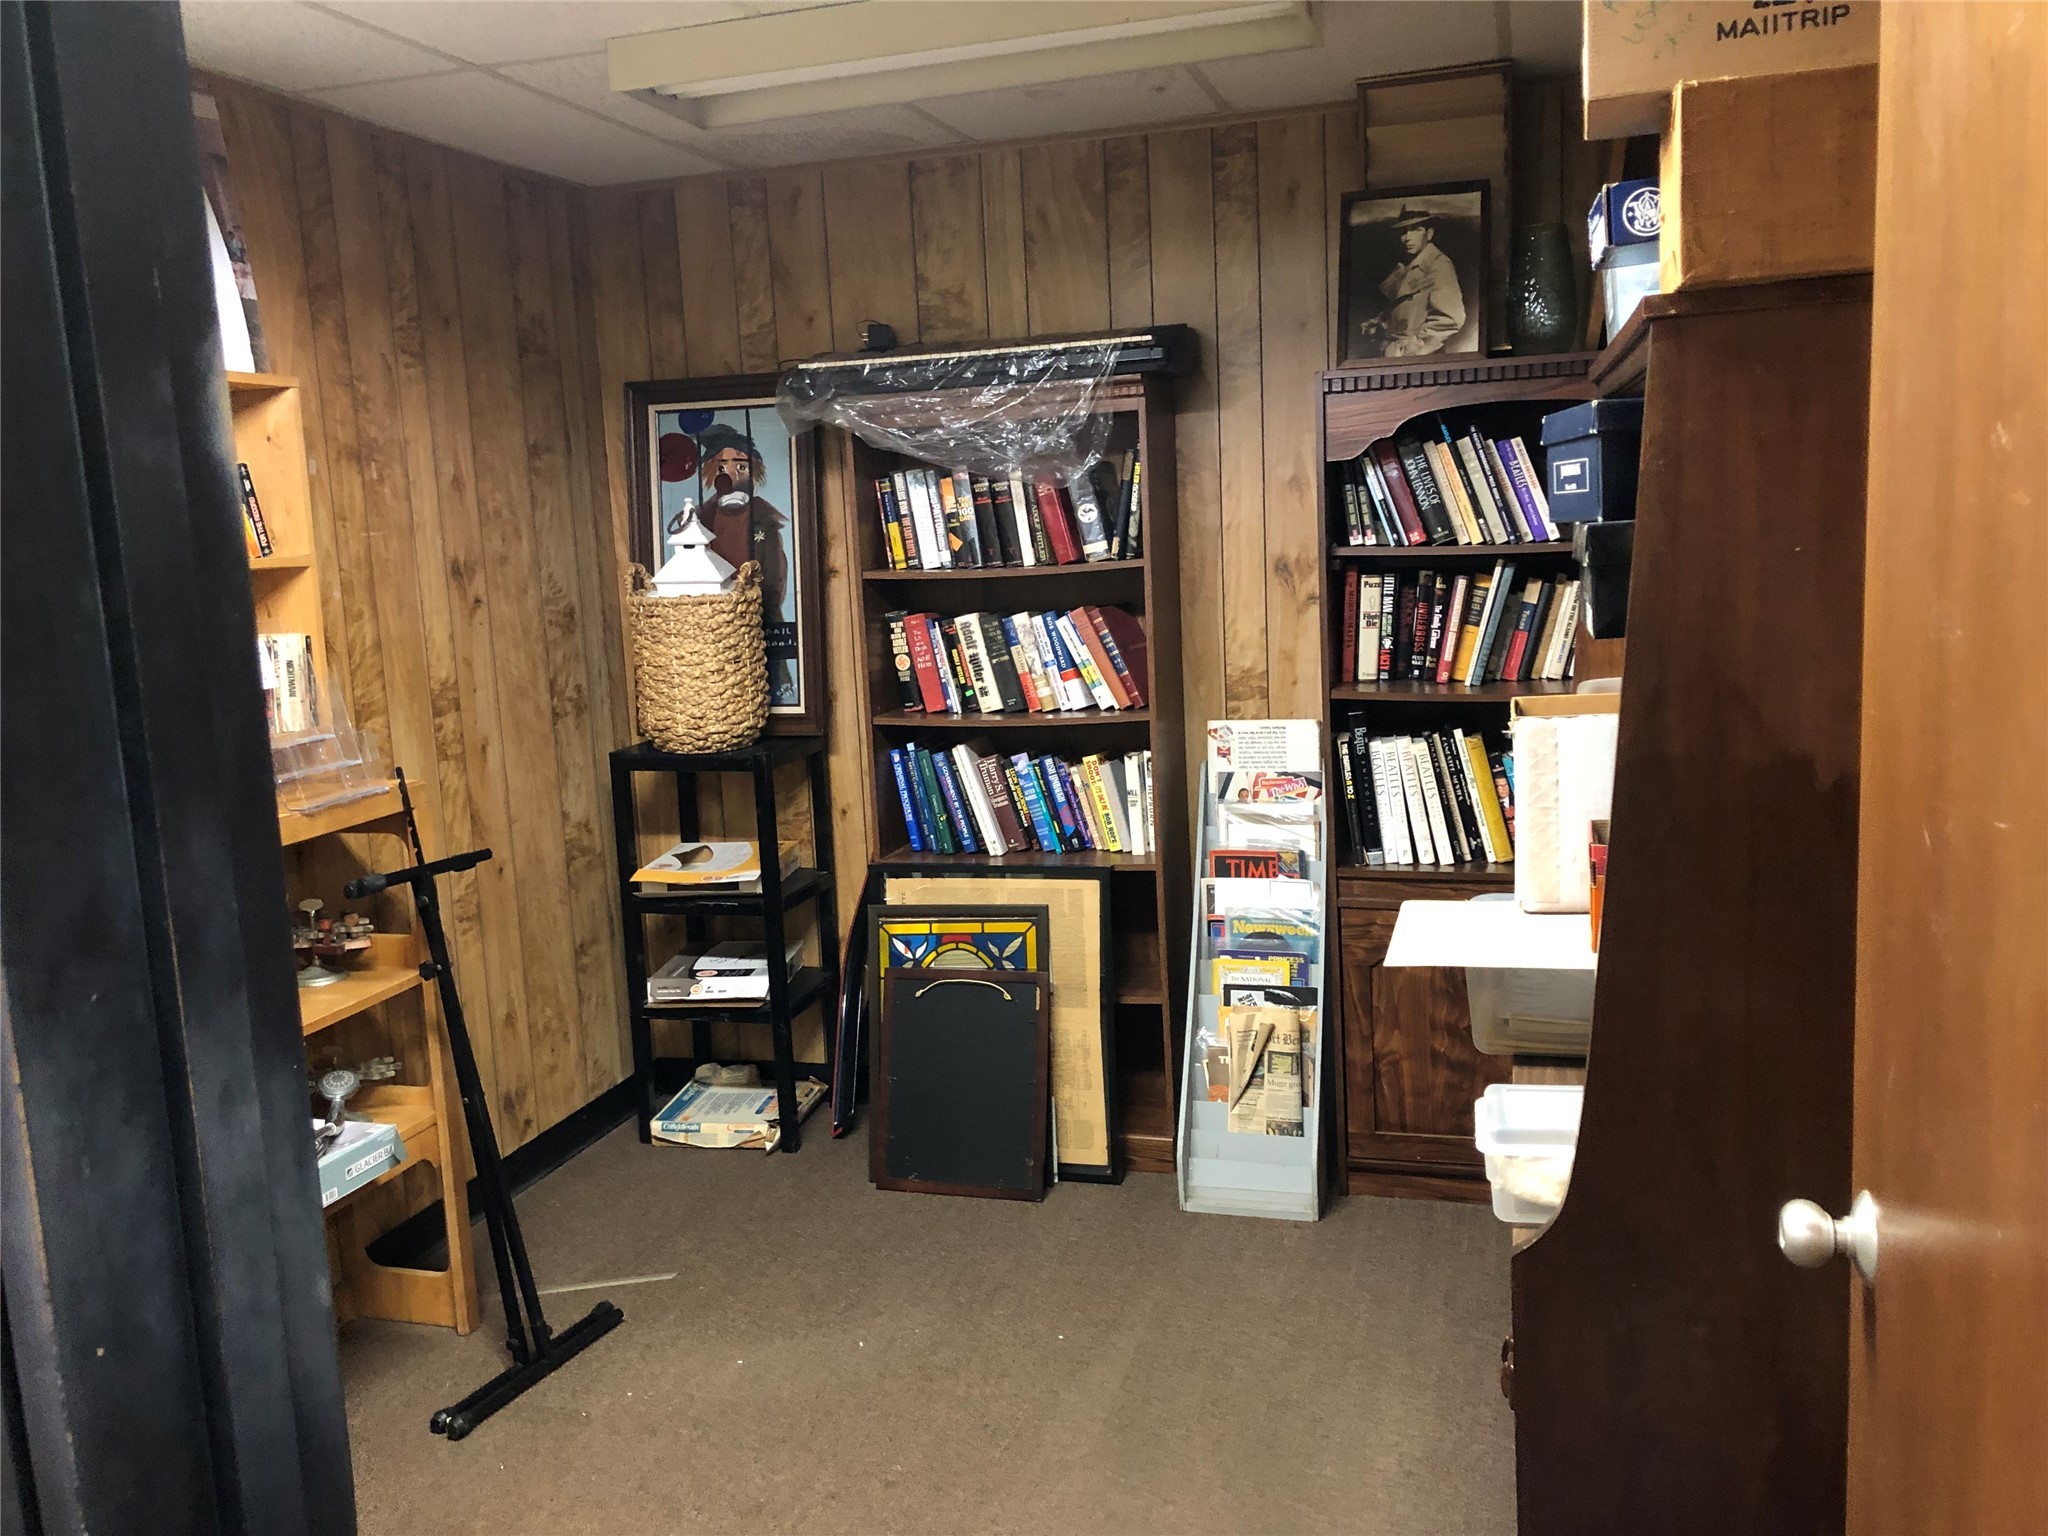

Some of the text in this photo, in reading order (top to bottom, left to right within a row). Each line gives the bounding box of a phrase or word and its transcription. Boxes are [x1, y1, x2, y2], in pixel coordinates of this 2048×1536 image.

[1716, 4, 1850, 41] MAIITRIP
[1404, 457, 1431, 511] JOHN LENNON
[1414, 453, 1442, 505] THE LIVES OF
[1509, 460, 1527, 488] BEATLES
[248, 495, 268, 547] FOR THE RECORD
[932, 503, 946, 535] PATTON
[957, 507, 975, 516] 100
[1031, 504, 1047, 562] ADOLF HITLER
[1382, 596, 1394, 613] MAN
[1434, 605, 1443, 613] The
[1519, 609, 1530, 630] Texas
[1414, 602, 1429, 653] UNDERBOSS
[1431, 613, 1443, 629] Family
[1565, 622, 1573, 639] ALAMO
[916, 654, 931, 662] Adolf
[960, 620, 978, 652] Adolf
[969, 650, 985, 683] Hitler
[1045, 616, 1054, 630] BOB
[1050, 631, 1067, 669] WOODWARD
[917, 661, 933, 669] Hitler
[1380, 649, 1391, 670] LACEY
[1341, 742, 1349, 754] THE
[980, 760, 994, 795] Truman
[987, 758, 1000, 785] Harry
[1045, 758, 1065, 803] RUSH LIMBAUGH
[1092, 759, 1102, 782] DON'T
[1342, 753, 1352, 780] BEATLES
[1354, 726, 1374, 826] BEATLES ANTHOLOGY
[1370, 751, 1386, 797] BEATLES
[1386, 751, 1402, 798] BEATLES
[1402, 750, 1418, 797] BEATLES
[1419, 752, 1438, 799] BEATLES
[896, 763, 913, 822] CRIMINAL PROCEDURE
[942, 766, 956, 802] GOVERNMENT
[954, 801, 960, 809] BY
[959, 819, 969, 838] PEOPLE
[1009, 767, 1029, 814] LEON JAWORSKI
[1018, 810, 1028, 827] POWER
[1104, 812, 1117, 843] BOB HOPE
[1226, 858, 1278, 878] TIME
[1232, 920, 1315, 937] Newsweek
[354, 1151, 383, 1174] GLACIER
